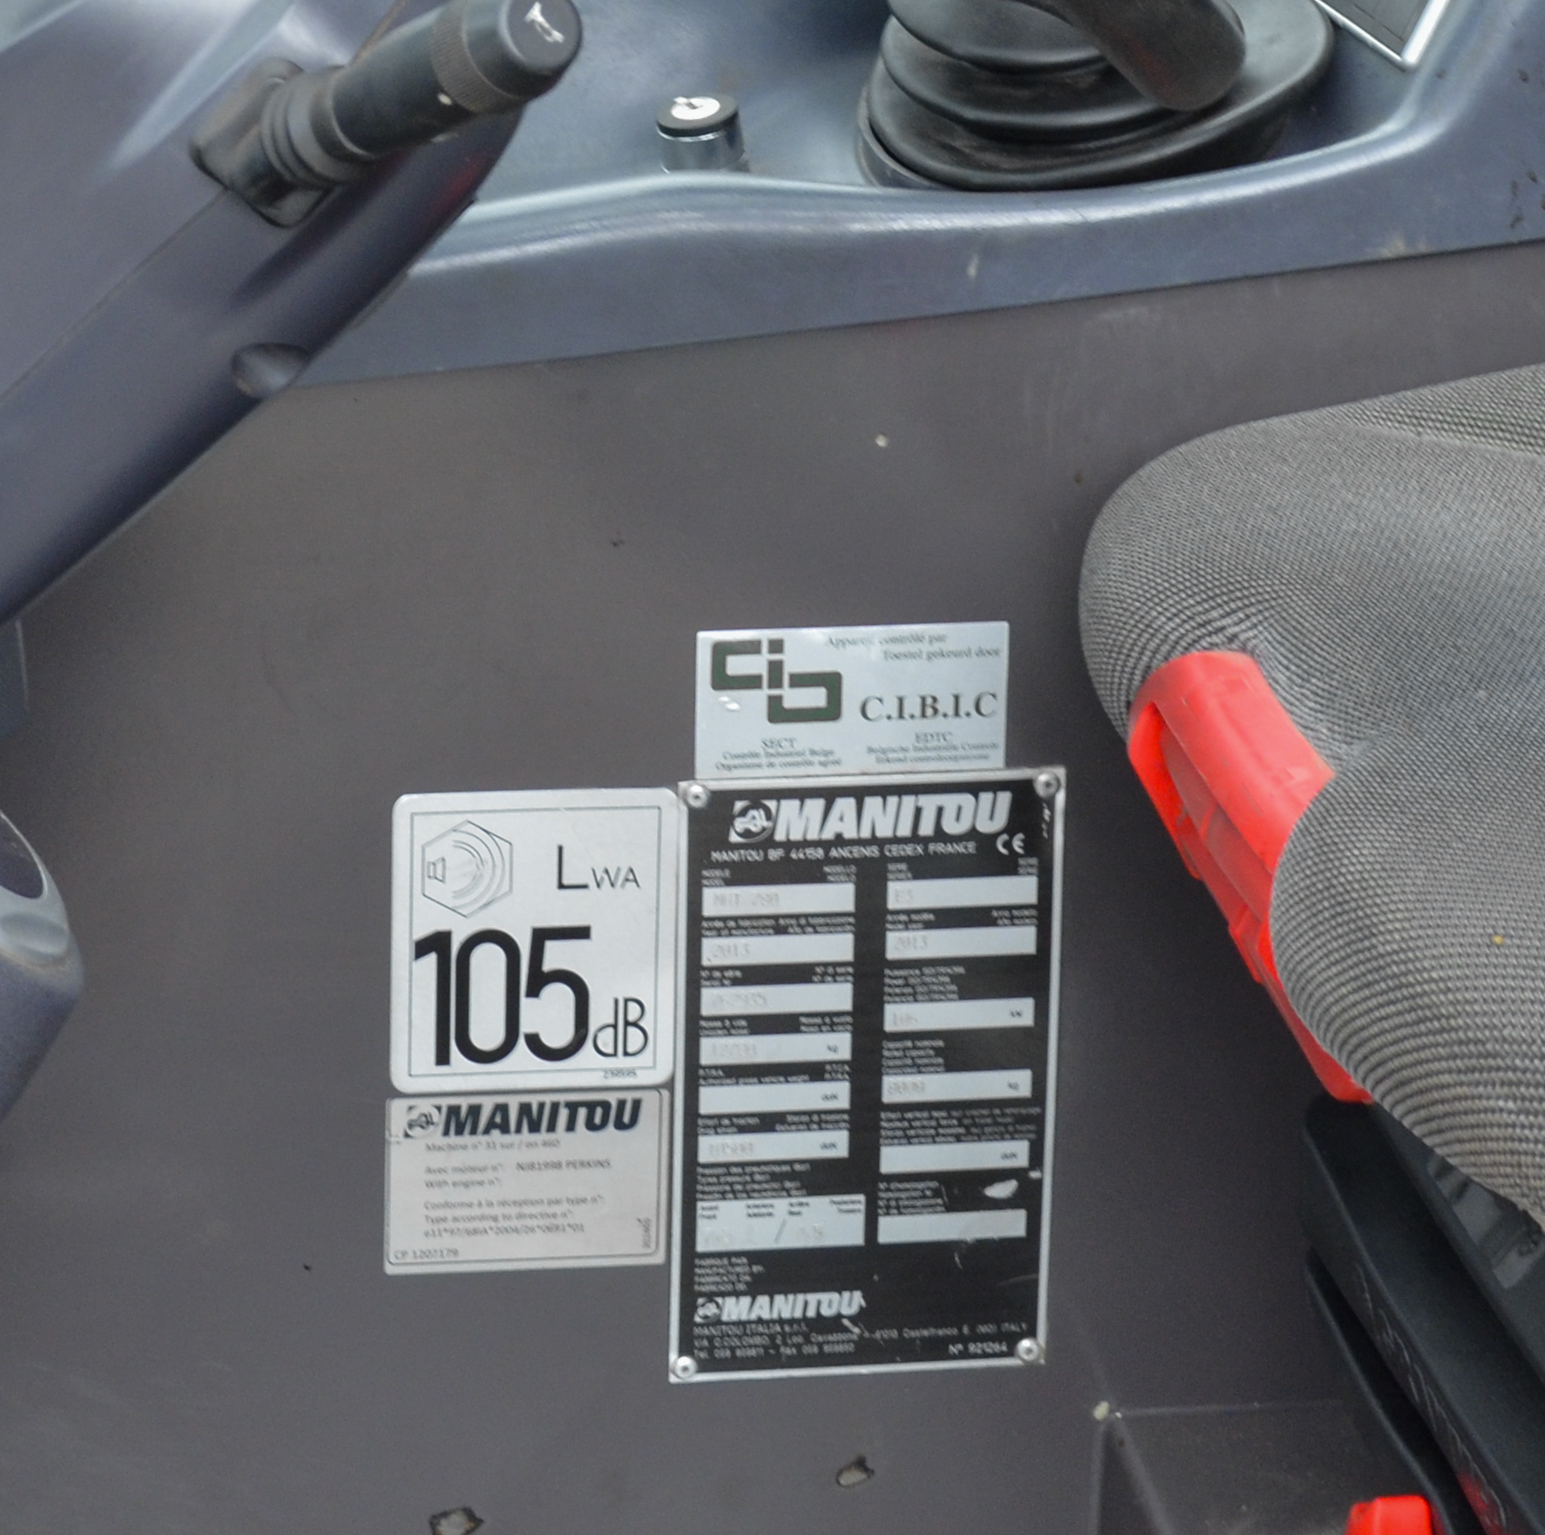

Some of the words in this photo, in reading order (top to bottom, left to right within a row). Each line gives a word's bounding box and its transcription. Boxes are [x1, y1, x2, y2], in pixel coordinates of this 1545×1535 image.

[860, 690, 999, 723] C.I.B.I.C
[762, 737, 797, 750] SECT
[774, 790, 1012, 842] MANITOU
[711, 849, 765, 863] MANITOU
[829, 844, 880, 859] ANCENIS
[883, 843, 925, 857] CEDEX
[928, 841, 978, 856] FRANCE
[893, 934, 929, 951] 2013
[414, 925, 591, 1067] 105
[593, 997, 649, 1058] dB
[441, 1097, 643, 1138] MANITOU
[424, 1141, 469, 1153] Machine
[424, 1165, 449, 1175] Avec
[565, 1158, 612, 1171] PERKINS
[424, 1180, 450, 1190] With
[452, 1179, 486, 1191] engine
[424, 1200, 475, 1211] Conforme
[424, 1213, 450, 1225] Type
[452, 1211, 500, 1224] according
[502, 1211, 512, 1221] to
[721, 1291, 863, 1322] MANITOU
[694, 1324, 743, 1337] MANITOU
[746, 1322, 781, 1335] ITALIA
